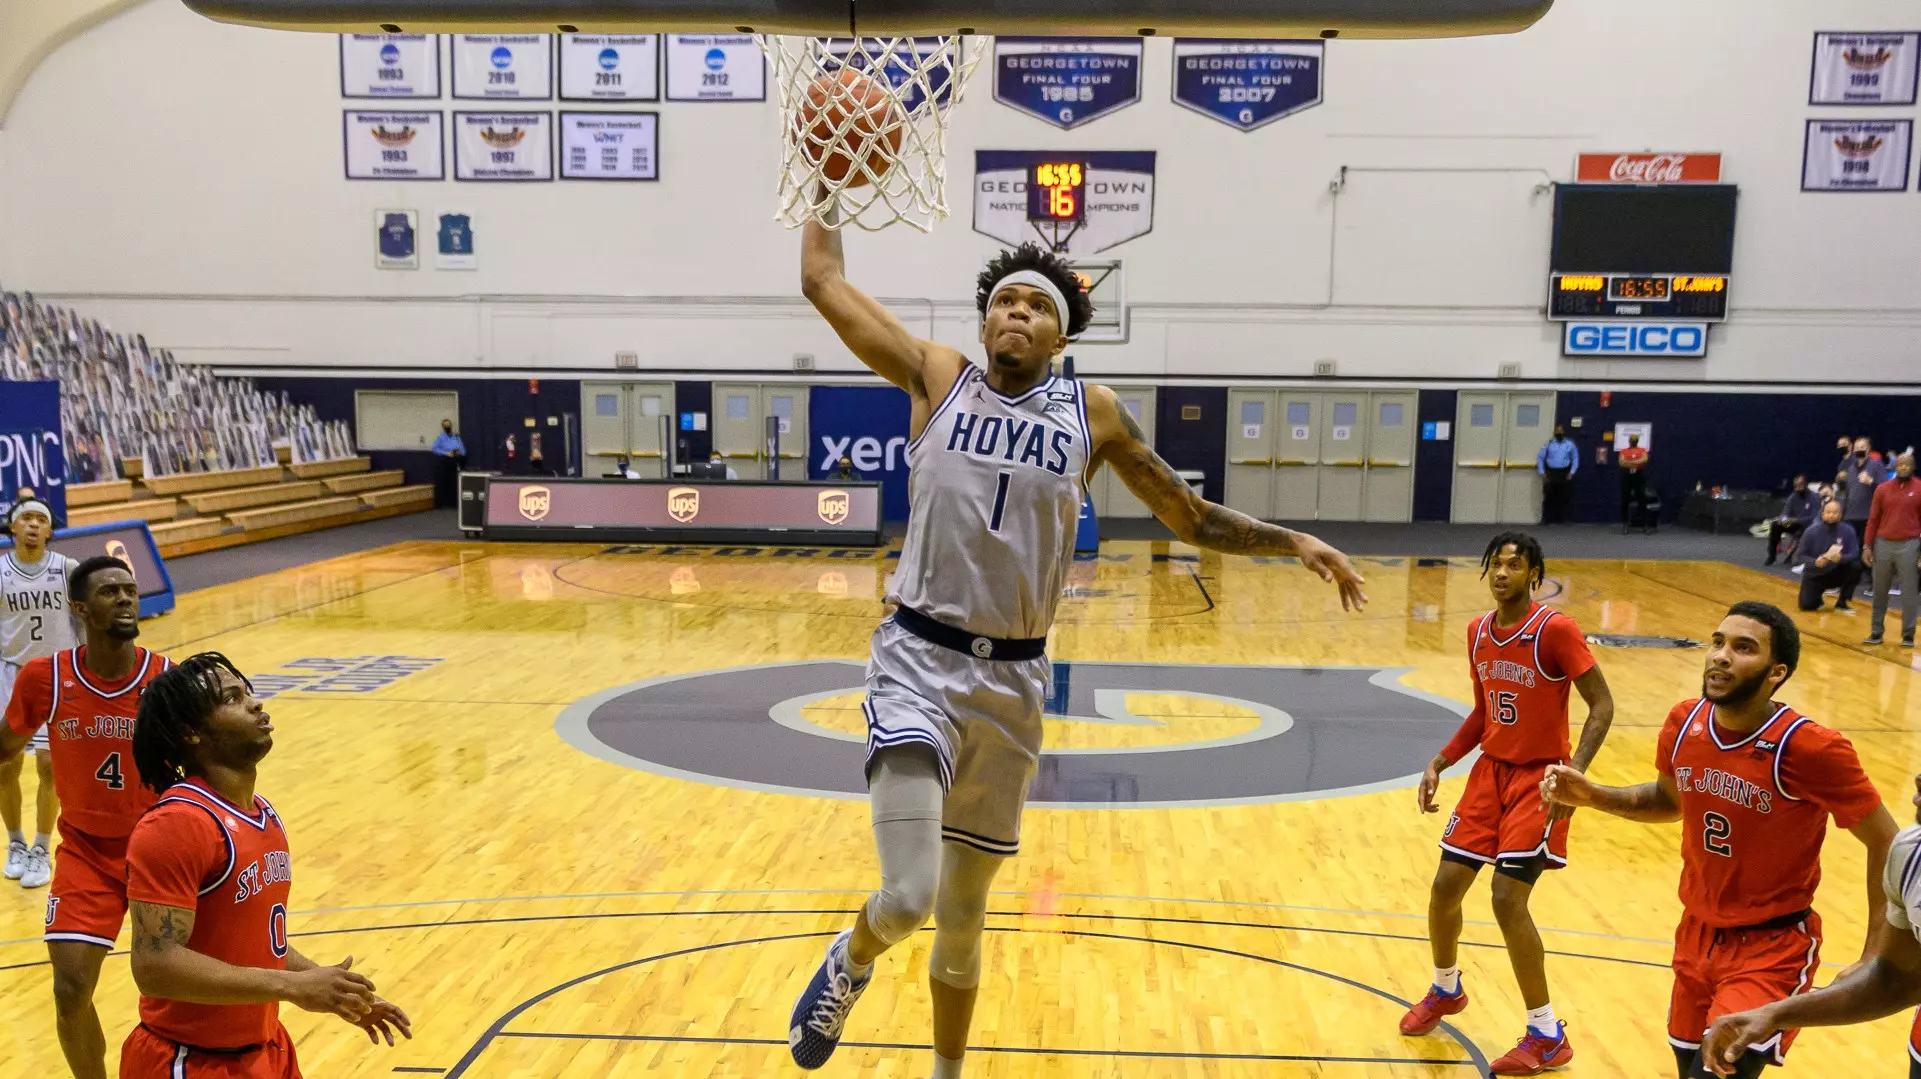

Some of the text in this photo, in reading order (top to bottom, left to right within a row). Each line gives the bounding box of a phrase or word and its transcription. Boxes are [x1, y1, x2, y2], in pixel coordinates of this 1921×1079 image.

[1007, 57, 1129, 69] GEORGETOWN
[1186, 58, 1310, 70] GEORGETOWN
[595, 73, 621, 86] 2011
[702, 73, 729, 86] 2012
[1023, 74, 1112, 84] FINAL FOUR
[1202, 75, 1292, 85] FINAL FOUR
[1219, 87, 1276, 103] 2007
[1050, 185, 1074, 217] 16
[1570, 326, 1702, 351] GEICO
[820, 436, 912, 471] xer
[946, 411, 1074, 477] HOYAS
[0, 433, 61, 490] PNC
[521, 496, 547, 515] ups
[671, 498, 697, 517] ups
[820, 500, 846, 519] ups
[987, 472, 1011, 534] 1
[7, 590, 62, 612] HOYAS
[30, 615, 43, 641] 2
[971, 637, 993, 659] G
[1489, 660, 1536, 688] JOHN'S
[1488, 690, 1519, 725] 15
[58, 718, 82, 740] ST.
[95, 752, 125, 790] 4
[1694, 767, 1772, 814] JOHN'S
[1703, 810, 1732, 857] 2
[234, 860, 262, 904] ST.
[269, 903, 288, 958] 0
